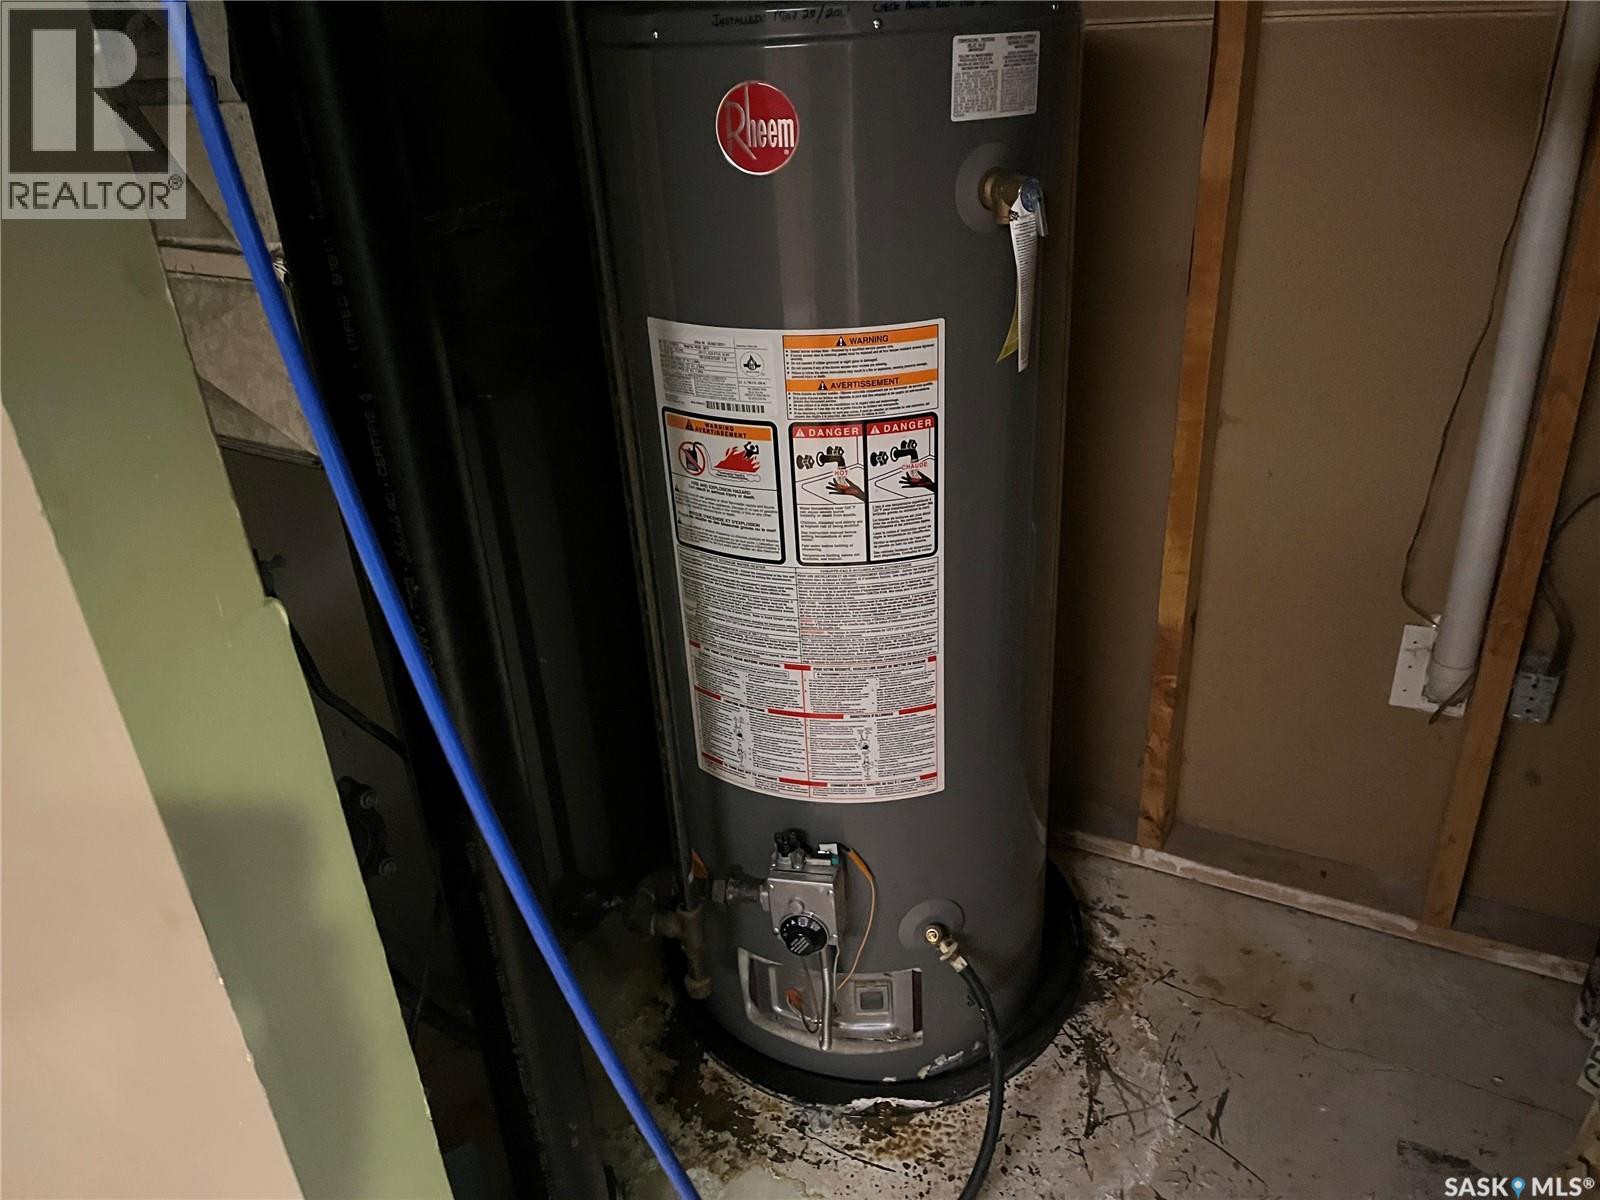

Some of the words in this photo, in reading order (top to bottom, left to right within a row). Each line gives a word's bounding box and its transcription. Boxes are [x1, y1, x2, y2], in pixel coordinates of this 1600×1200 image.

[722, 84, 795, 160] Rheem
[849, 334, 889, 345] WARNING
[830, 377, 900, 389] AVERTISSEMENT
[704, 422, 734, 431] WARNING
[883, 418, 933, 433] DANGER
[694, 426, 747, 439] AVERTISSEMENT
[808, 427, 859, 437] DANGER
[901, 461, 928, 470] CHAUDE
